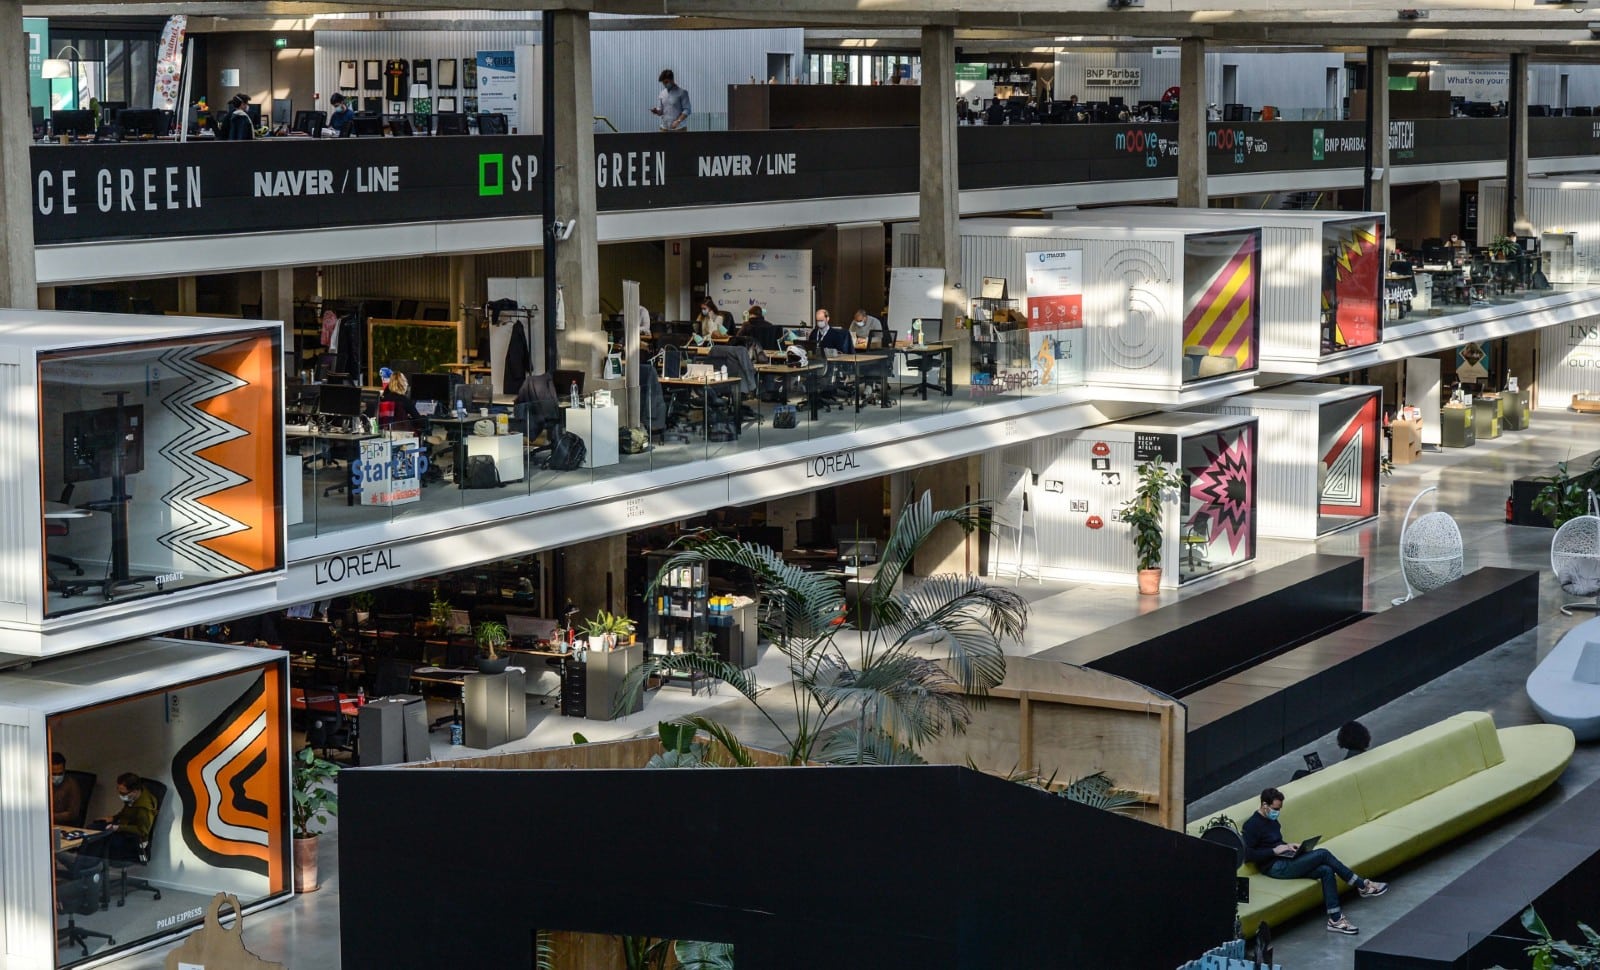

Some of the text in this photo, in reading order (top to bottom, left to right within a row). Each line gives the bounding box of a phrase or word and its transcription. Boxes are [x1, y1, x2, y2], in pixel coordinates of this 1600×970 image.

[1087, 69, 1139, 78] BNP Paribas
[1324, 138, 1340, 152] BNP
[1397, 121, 1415, 149] TECH
[597, 151, 665, 188] GREEN
[698, 155, 752, 177] NAVER
[767, 153, 796, 175] LINE
[97, 166, 201, 213] GREEN
[254, 170, 334, 197] NAVER
[356, 166, 399, 193] LINE
[806, 451, 861, 478] L'ORÉAL
[155, 571, 184, 584] STARGATE
[315, 548, 401, 585] L'ORÉAL
[157, 907, 202, 929] POLAR EXPRESS
